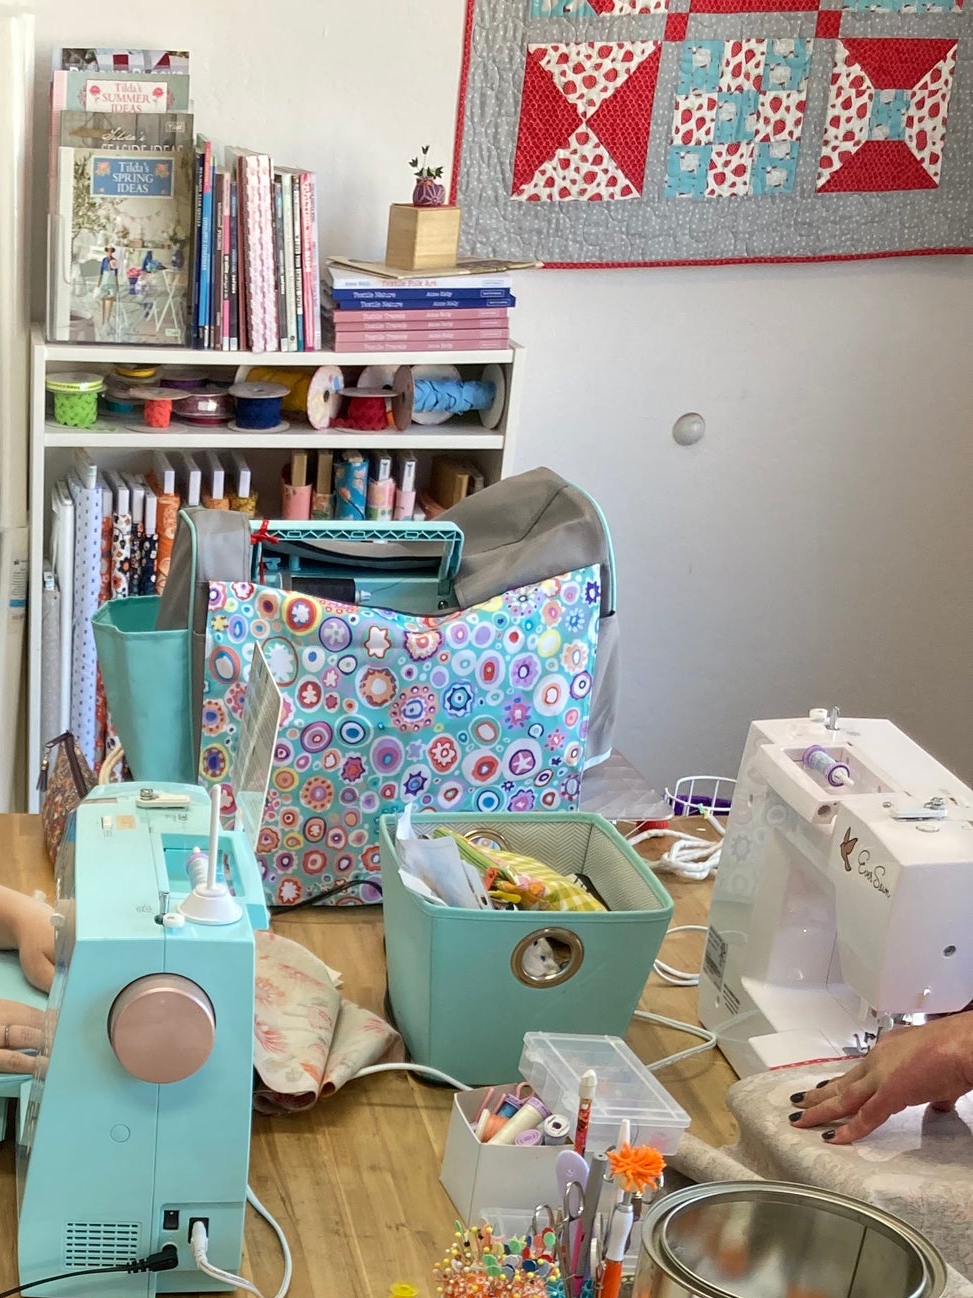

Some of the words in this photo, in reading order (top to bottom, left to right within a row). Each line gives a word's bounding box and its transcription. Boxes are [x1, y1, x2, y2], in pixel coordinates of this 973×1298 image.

[102, 94, 150, 104] SUMMER
[118, 161, 150, 173] Tilda's
[113, 173, 154, 184] SPRING
[117, 183, 149, 193] IDEAS
